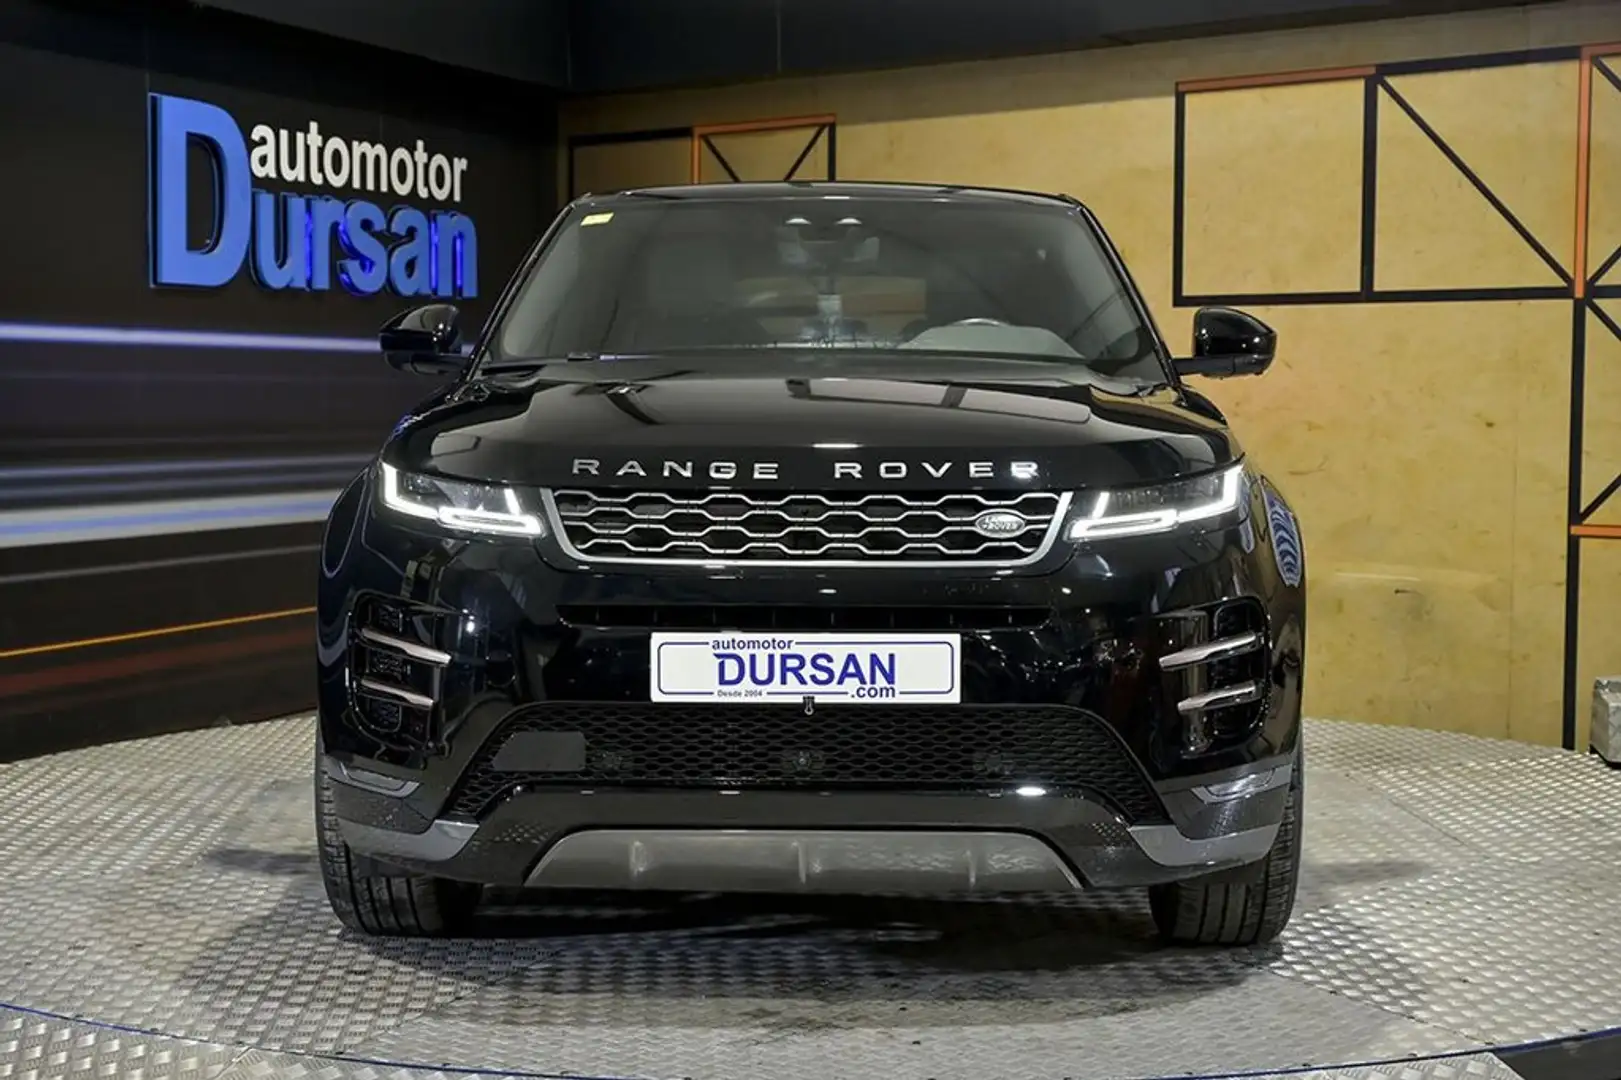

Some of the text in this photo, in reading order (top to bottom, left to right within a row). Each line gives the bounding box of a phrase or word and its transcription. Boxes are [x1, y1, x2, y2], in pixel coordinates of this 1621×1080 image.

[250, 121, 468, 202] automotor
[149, 92, 478, 299] Dursan
[572, 459, 1039, 480] RANGE ROVER
[712, 637, 794, 650] automotor
[713, 653, 895, 685] DURSAN
[717, 690, 762, 698] Desde 2004
[851, 686, 895, 698] .com
